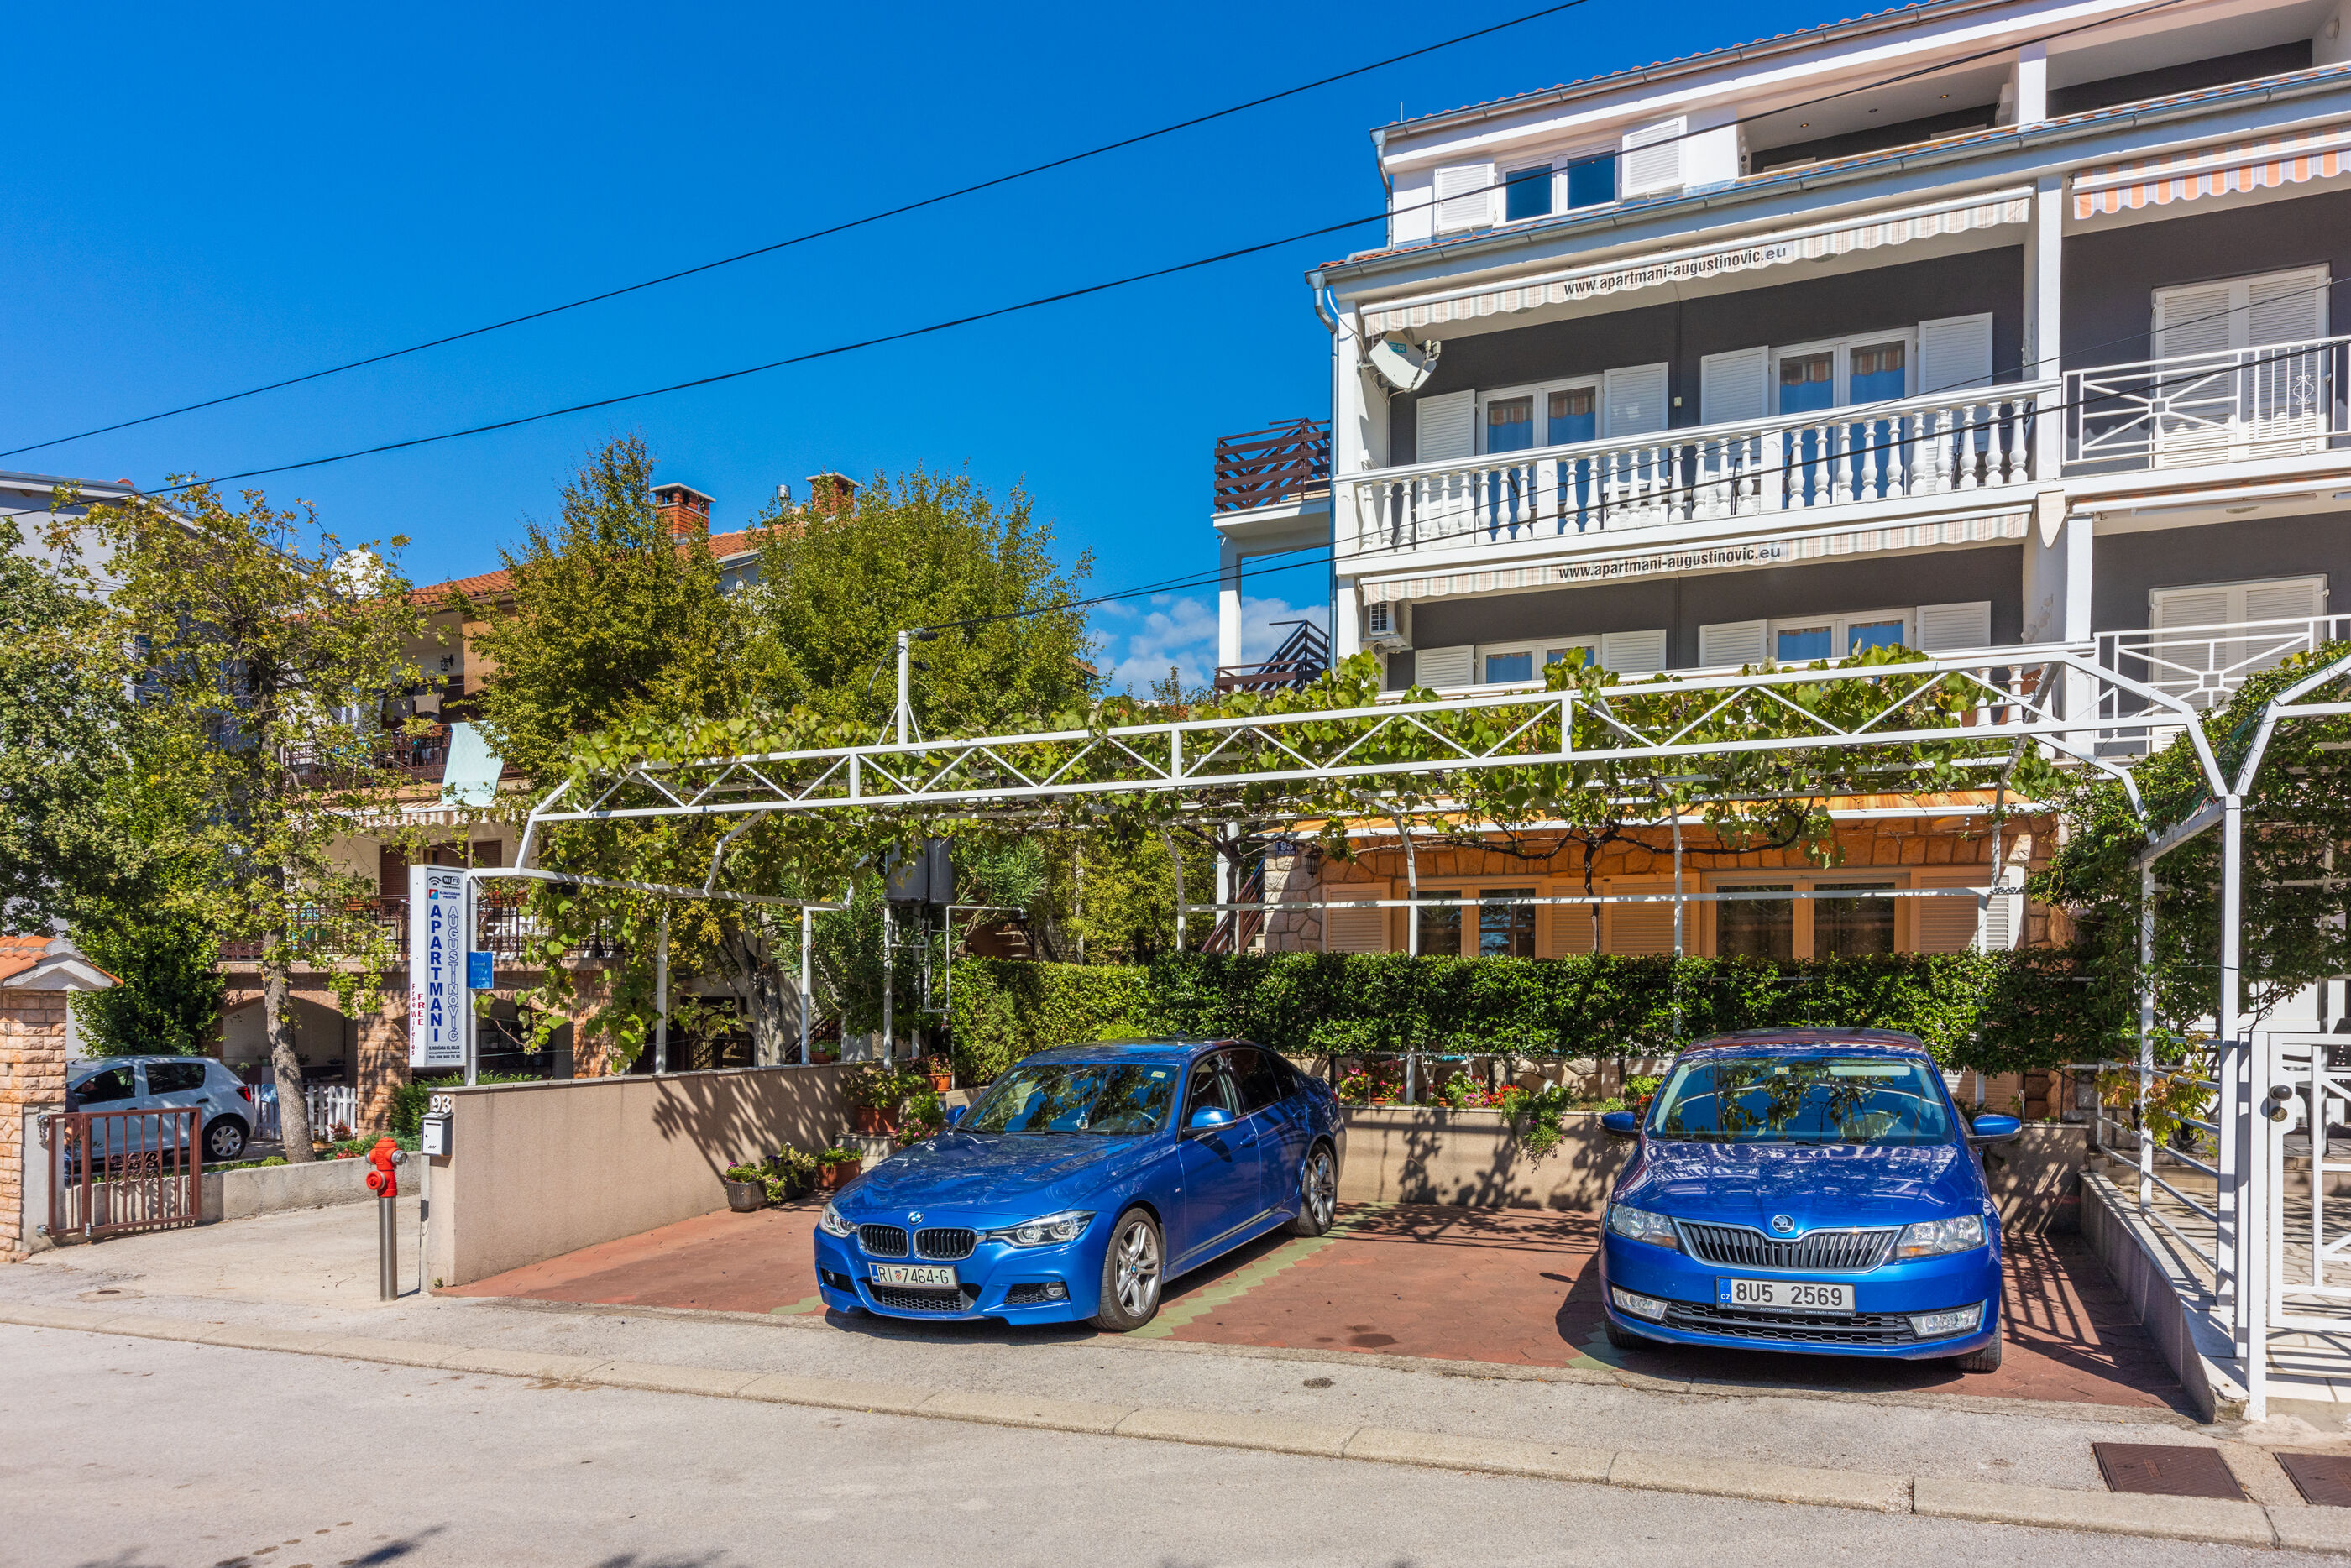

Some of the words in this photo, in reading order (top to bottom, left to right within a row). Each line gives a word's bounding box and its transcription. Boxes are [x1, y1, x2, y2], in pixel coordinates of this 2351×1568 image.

[1564, 247, 1786, 295] www.apartmani-augustinovic.eu
[1558, 546, 1781, 578] www.apartmani-augustinovic.eu
[430, 904, 442, 1042] APARTMANI
[432, 1094, 451, 1114] 93
[878, 1267, 892, 1282] RI
[901, 1268, 949, 1284] 7464-G
[1736, 1283, 1773, 1303] 8U5
[1791, 1286, 1842, 1306] 2569
